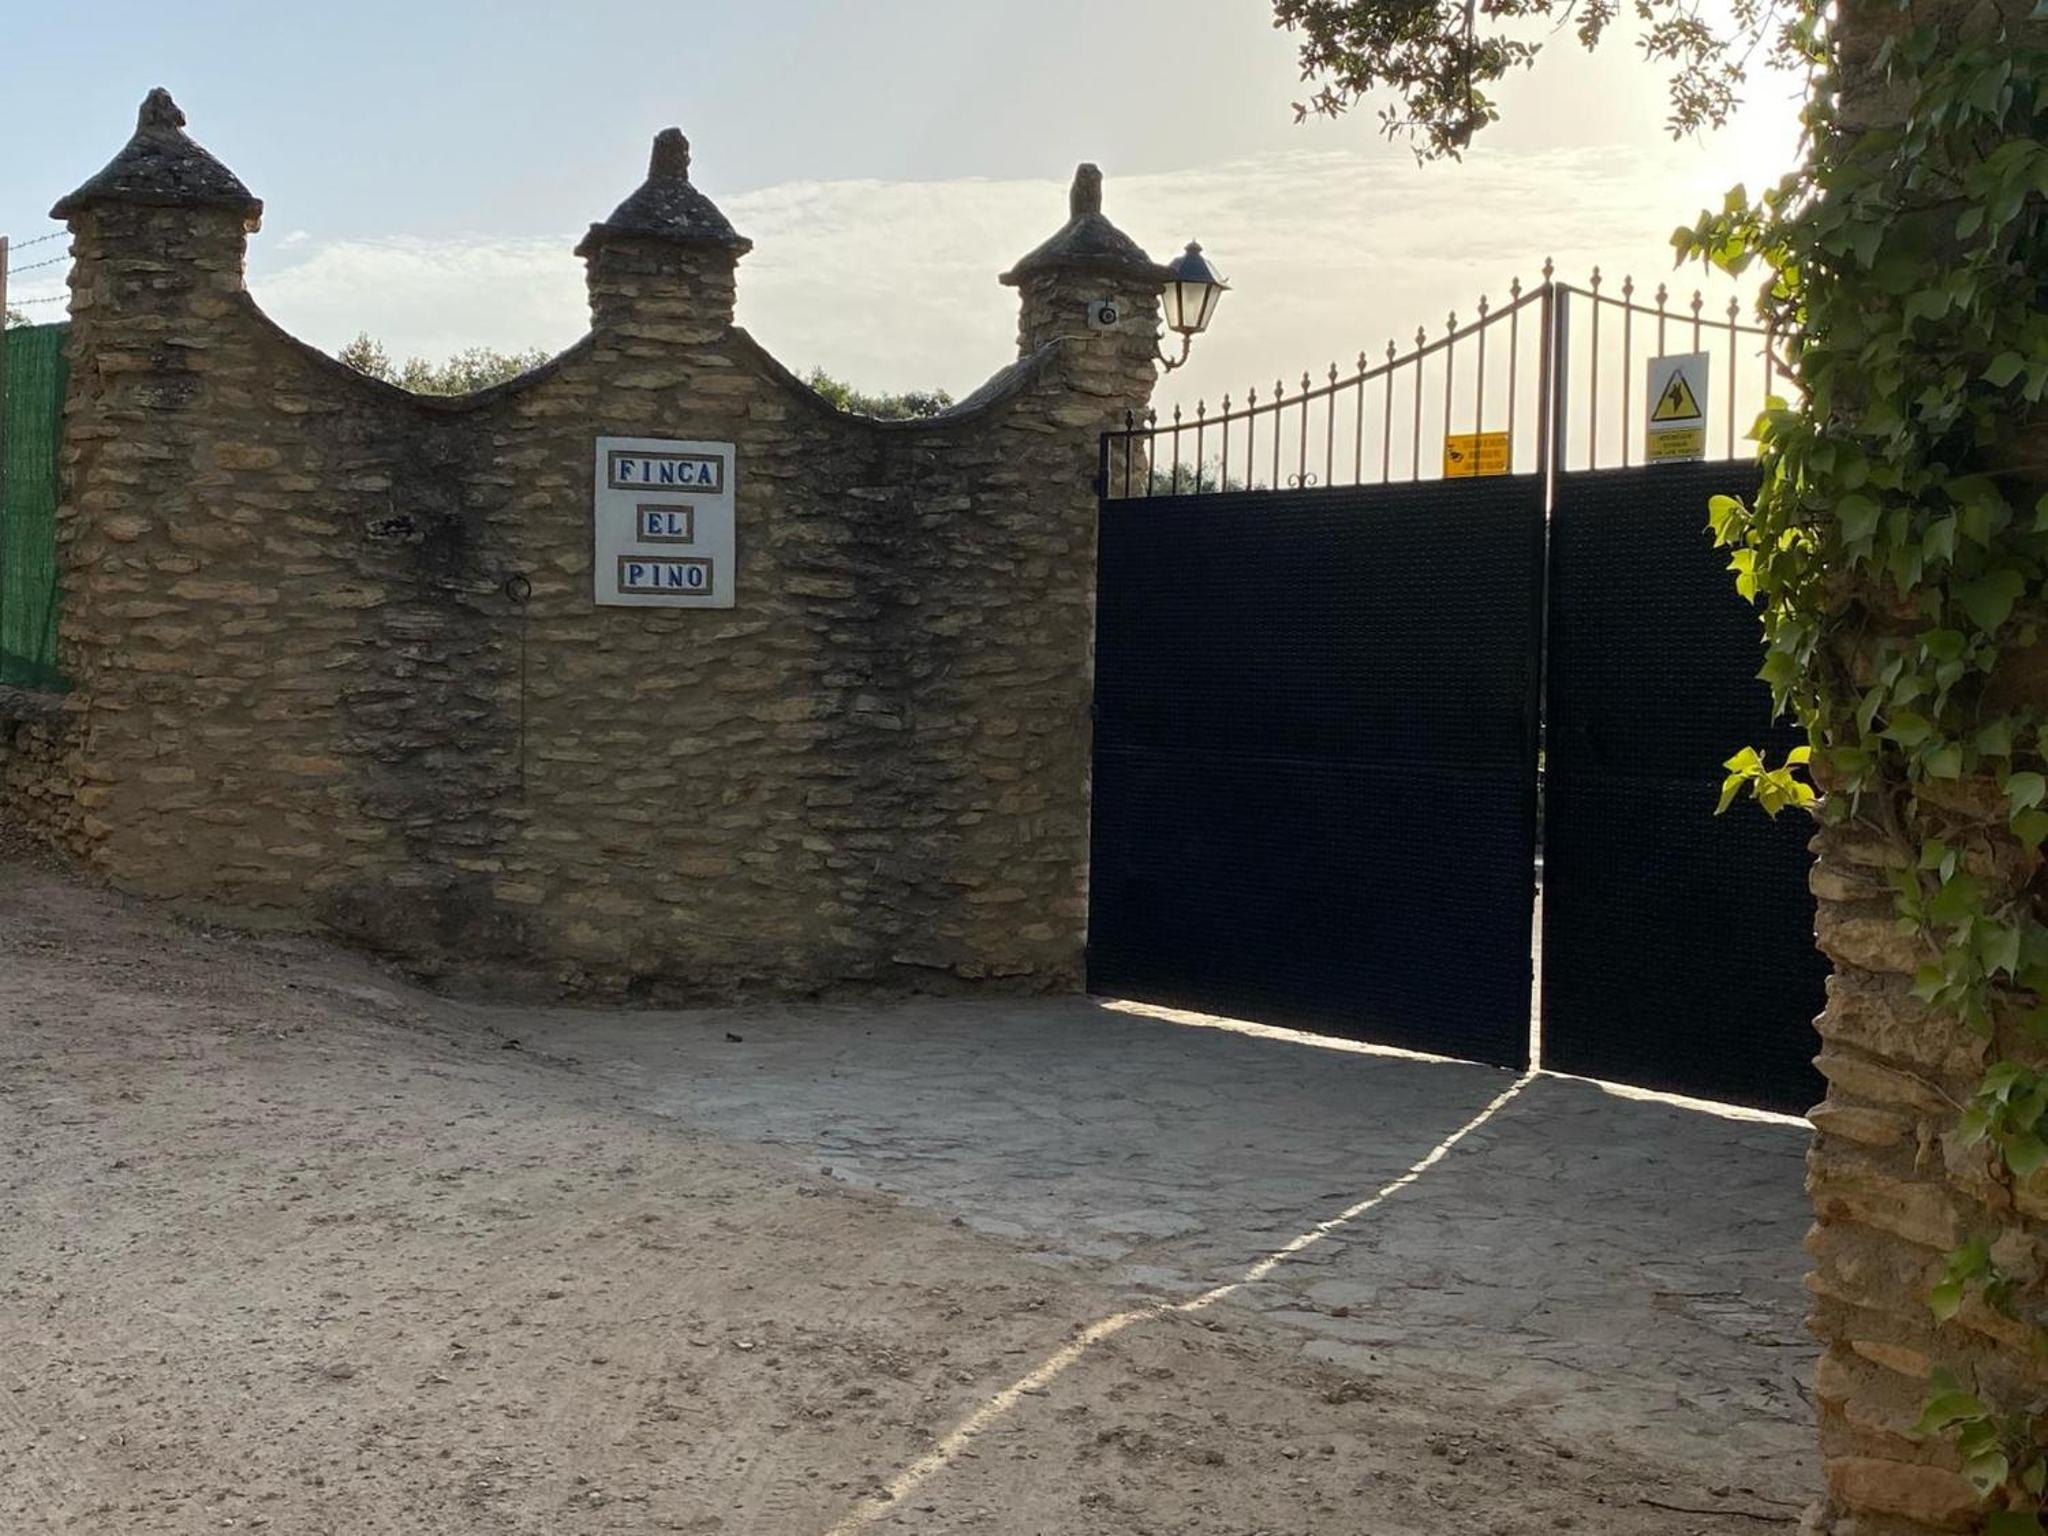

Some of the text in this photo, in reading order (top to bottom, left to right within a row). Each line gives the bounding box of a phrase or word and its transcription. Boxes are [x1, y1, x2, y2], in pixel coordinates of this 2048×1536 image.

[619, 459, 712, 484] FINCA
[648, 513, 682, 535] EL
[629, 564, 703, 587] PINO
